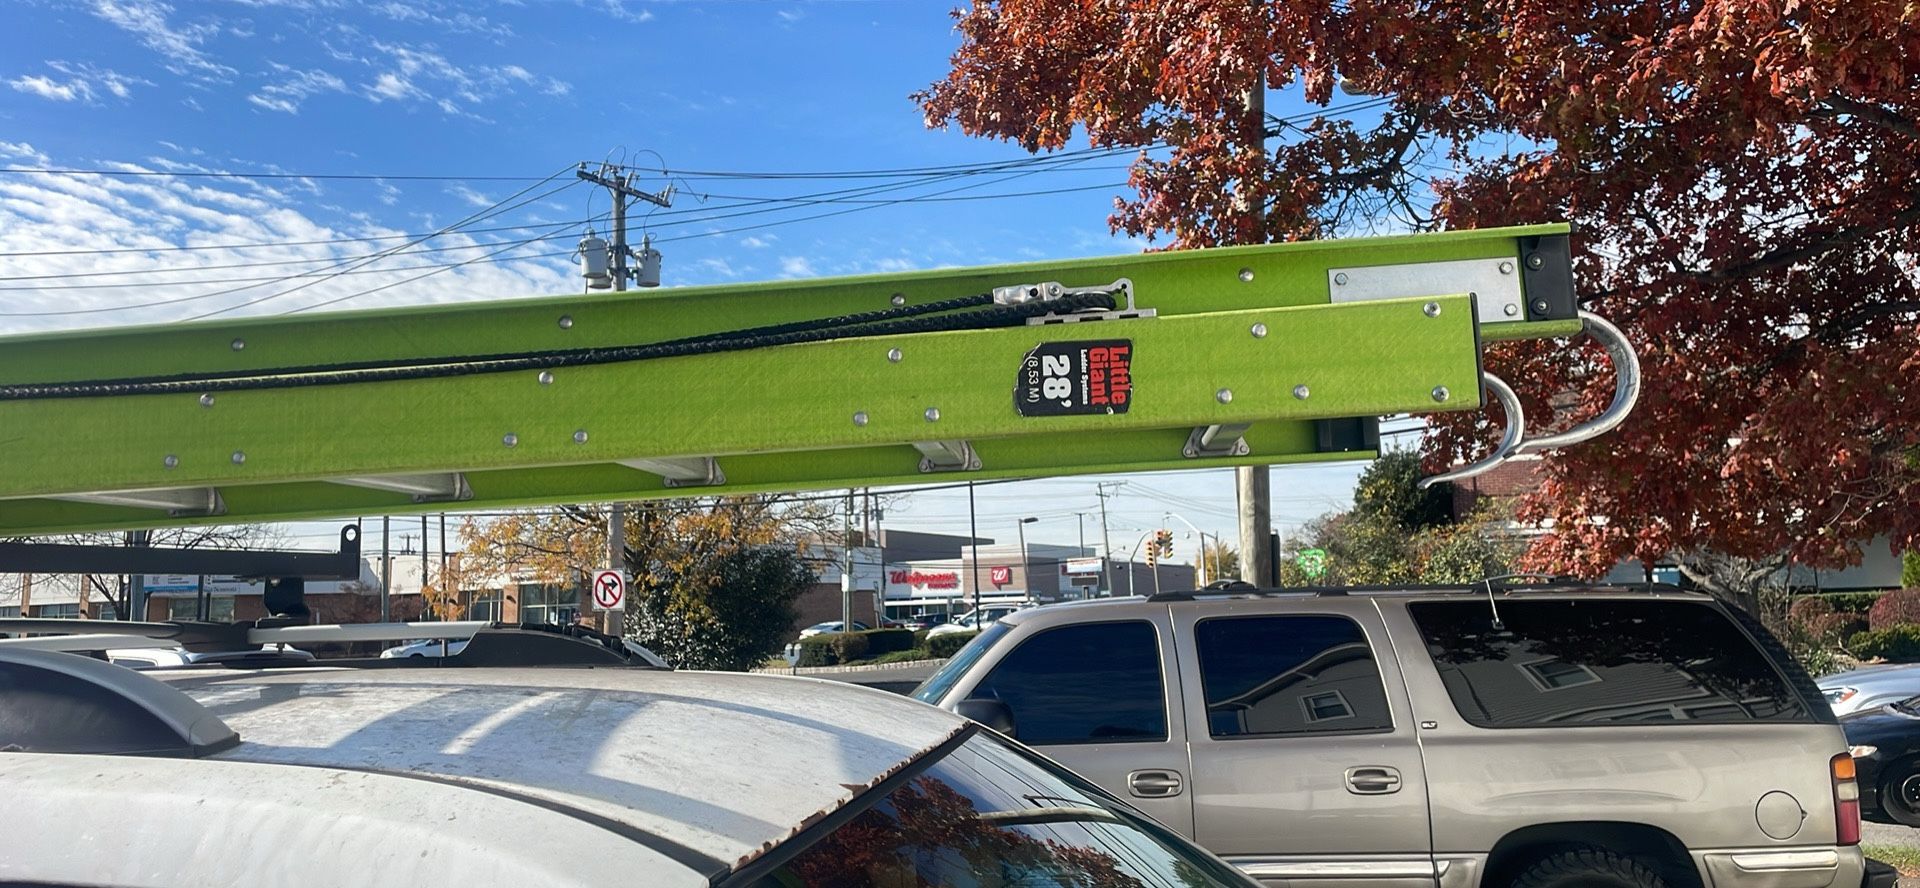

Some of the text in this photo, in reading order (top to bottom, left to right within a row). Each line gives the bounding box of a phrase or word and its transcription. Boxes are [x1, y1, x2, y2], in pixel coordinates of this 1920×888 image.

[1026, 356, 1040, 403] (8,53 M)
[1042, 354, 1072, 408] 28'
[1080, 349, 1089, 405] Ladder Systems
[1089, 347, 1109, 405] Giant
[1109, 346, 1130, 405] Little
